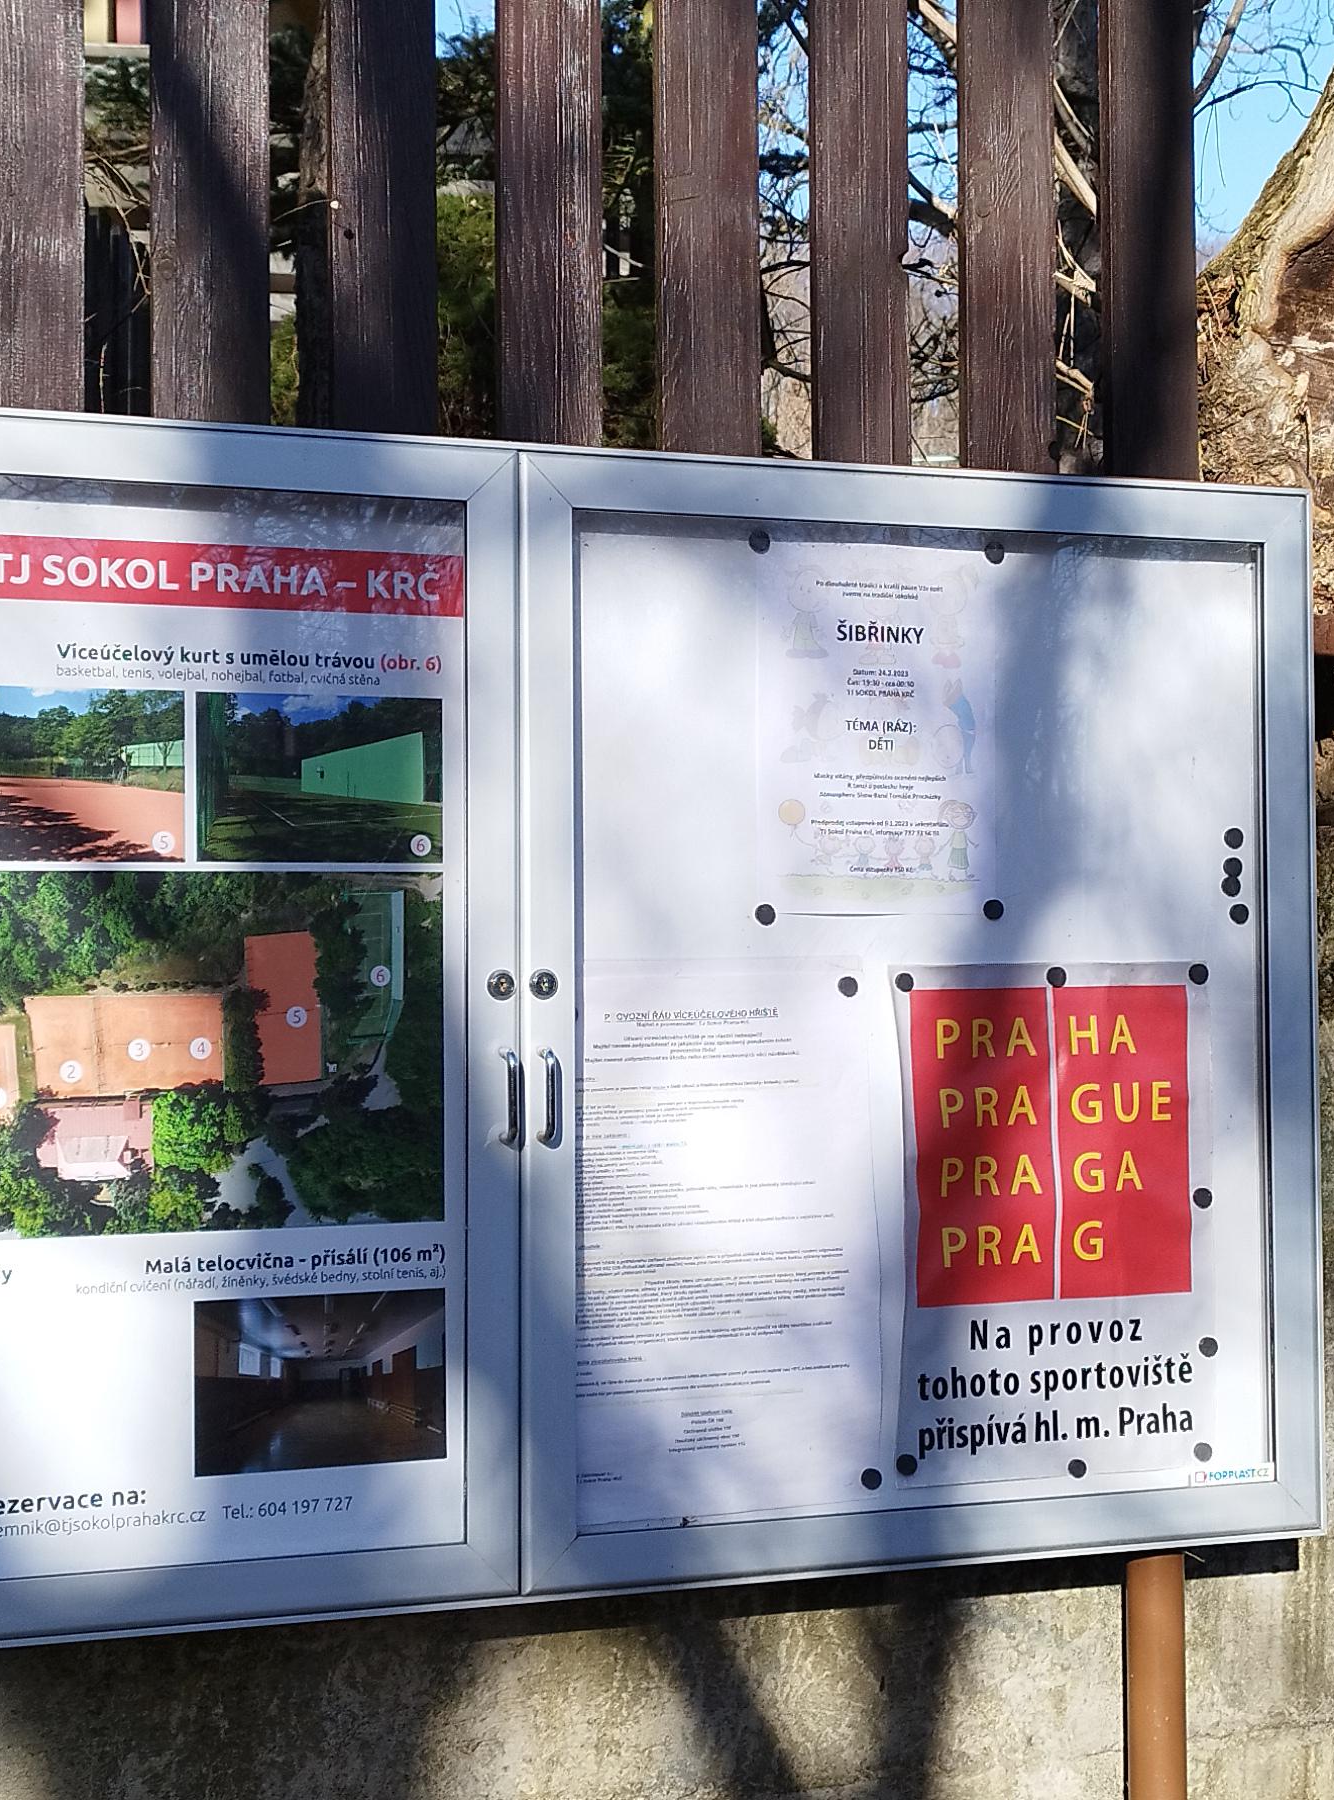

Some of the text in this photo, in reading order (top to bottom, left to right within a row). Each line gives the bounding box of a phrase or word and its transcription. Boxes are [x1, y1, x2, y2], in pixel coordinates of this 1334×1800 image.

[43, 554, 179, 591] SOKOL
[191, 562, 327, 597] PRAHA
[368, 564, 440, 600] KRČ
[836, 619, 924, 644] ŠIBŘINKY
[57, 642, 442, 674] Víceúčelový kurt s umělou trávou (obr. 6)
[57, 665, 380, 686] basketbal, tenis, volejbal, nohejbal, fotbal, cvičná stěna
[845, 718, 917, 733] TÉMA (RÁZ):
[868, 736, 894, 751] DĚTI
[160, 835, 169, 849] 5
[415, 837, 426, 853] 6
[376, 969, 385, 983] 6
[293, 1010, 301, 1024] 5
[196, 1041, 206, 1055] 4
[936, 1015, 1137, 1059] PRA HA
[135, 1042, 144, 1057] 3
[67, 1064, 76, 1079] 2
[939, 1081, 1172, 1129] PRA GUE
[940, 1150, 1143, 1198] PRA GA
[941, 1220, 1104, 1268] PRA G
[145, 1256, 191, 1275] Malá
[311, 1248, 368, 1269] přísálí
[373, 1247, 411, 1267] (106
[76, 1280, 127, 1295] kondiční
[130, 1278, 171, 1293] cvičení
[174, 1275, 219, 1292] (nářadí,
[321, 1269, 359, 1284] bedny,
[362, 1267, 394, 1281] stolní
[397, 1267, 427, 1280] tenis,
[969, 1318, 1143, 1356] Na provoz
[918, 1352, 1193, 1401] tohoto sportoviště
[918, 1403, 1193, 1460] přispívá hl. m. Praha
[112, 1488, 146, 1507] na:
[222, 1504, 253, 1520] Tel.:
[258, 1502, 286, 1518] 604
[293, 1499, 319, 1515] 197
[324, 1496, 353, 1512] 727
